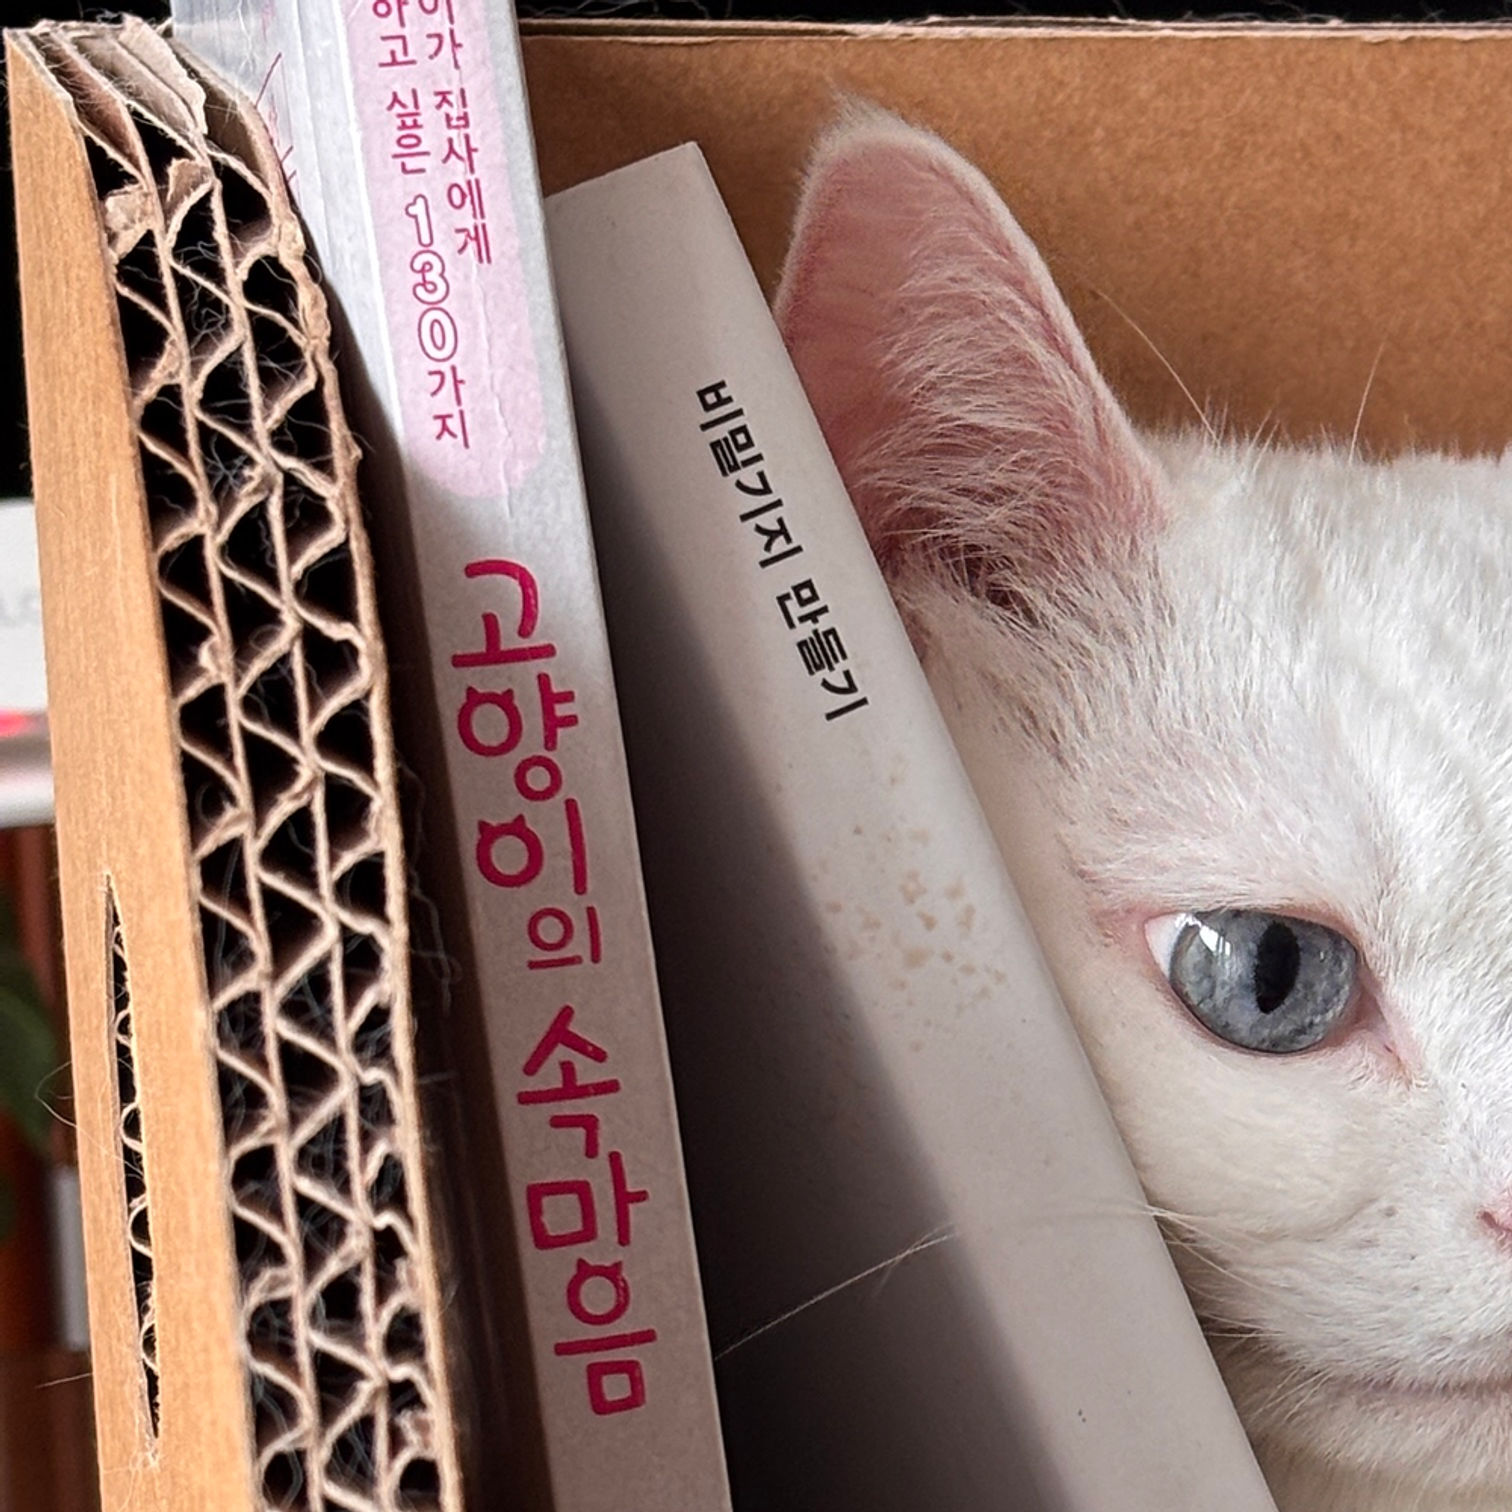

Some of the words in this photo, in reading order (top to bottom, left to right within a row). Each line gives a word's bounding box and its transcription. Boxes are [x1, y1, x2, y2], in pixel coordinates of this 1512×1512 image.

[386, 88, 431, 174] 싶은
[434, 88, 491, 265] 집사에게
[406, 194, 469, 449] 130가지
[696, 380, 804, 568] 비밀기지
[775, 578, 869, 721] 만들기
[451, 559, 601, 969] 고양이의
[517, 1004, 656, 1415] 속마음
